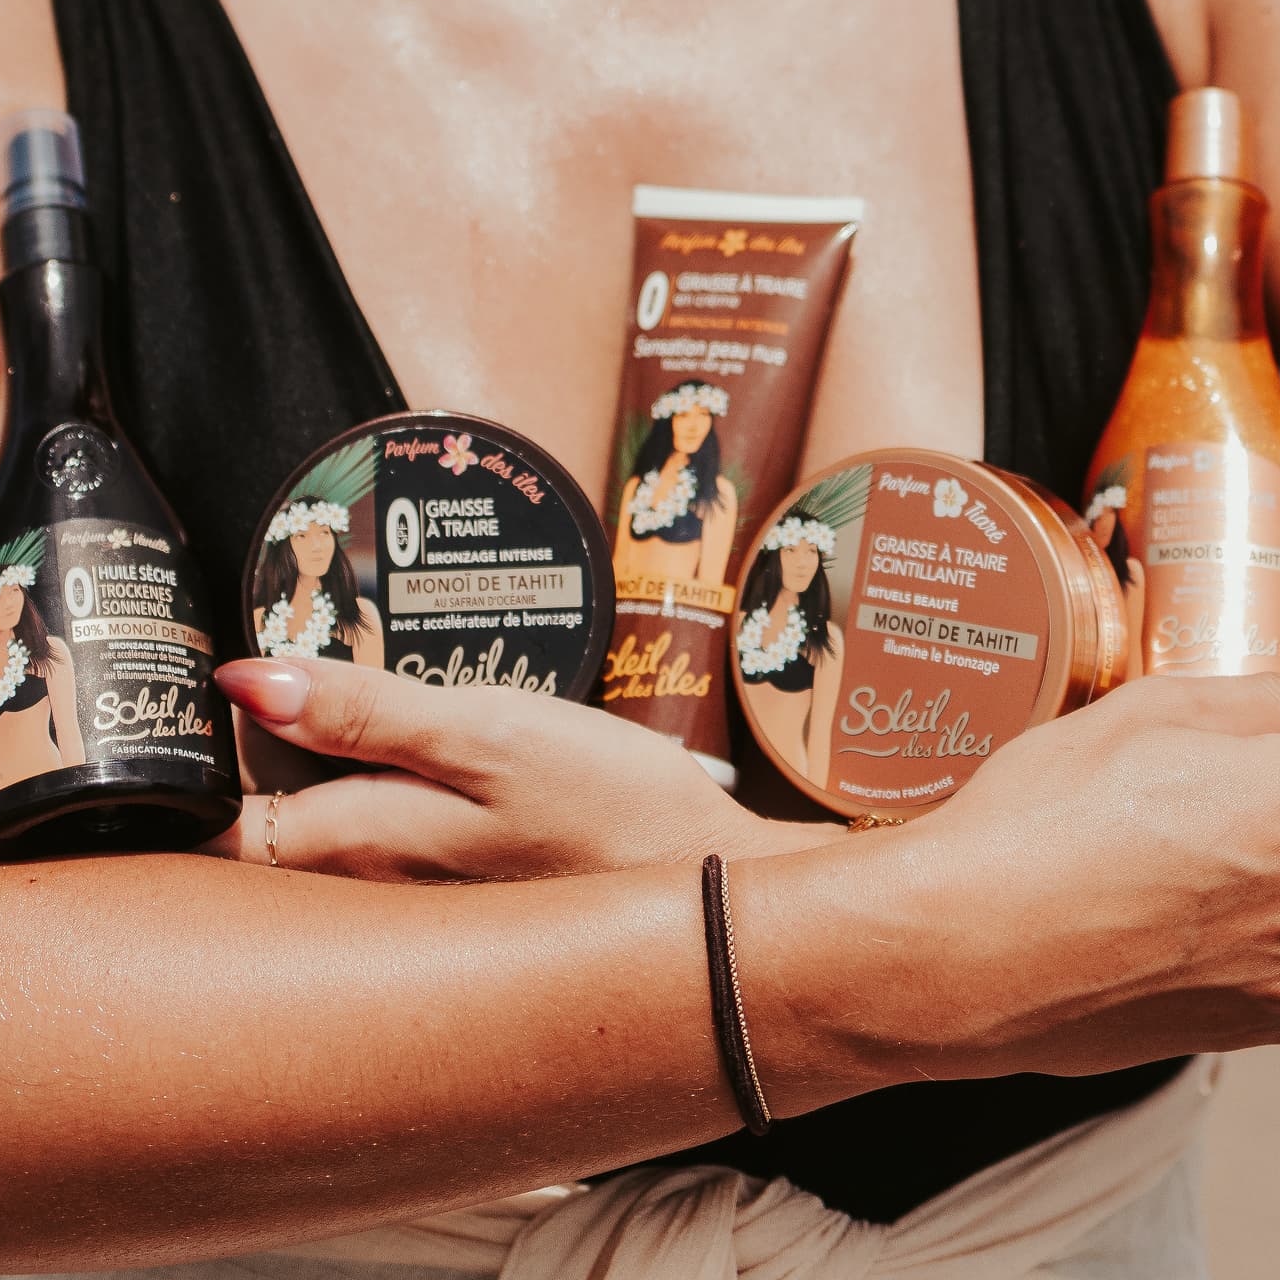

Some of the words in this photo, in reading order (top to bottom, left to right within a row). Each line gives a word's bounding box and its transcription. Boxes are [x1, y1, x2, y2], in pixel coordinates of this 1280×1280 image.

[676, 273, 738, 293] GRAISSE
[740, 272, 753, 293] À
[754, 274, 808, 300] TRAIRE
[637, 271, 669, 331] 0
[634, 335, 707, 359] Sensation
[708, 340, 751, 363] peau
[752, 344, 788, 367] nue
[385, 437, 439, 462] Parfum
[480, 452, 513, 480] des
[425, 497, 495, 519] GRAISSE
[878, 472, 930, 498] Parfum
[964, 500, 1007, 544] Tiaré
[61, 532, 107, 548] Parfum
[386, 497, 420, 567] 0
[426, 518, 440, 538] À
[442, 519, 501, 538] TRAIRE
[426, 550, 497, 566] BRONZAGE
[499, 547, 553, 563] INTENSE
[875, 535, 938, 560] GRAISSE
[939, 544, 952, 564] À
[955, 548, 1008, 573] TRAIRE
[1159, 544, 1210, 561] MONOÏ
[98, 564, 137, 581] HUILE
[139, 563, 177, 587] SÈCHE
[406, 570, 471, 595] MONOÏ
[478, 577, 501, 592] DE
[508, 574, 564, 591] TAHITI
[872, 557, 977, 588] SCINTILLANTE
[65, 567, 94, 617] 0
[98, 584, 174, 603] TROCKENES
[434, 598, 447, 609] AU
[449, 596, 484, 608] SAFRAN
[487, 592, 537, 608] D'OCÉANIE
[617, 577, 643, 595] NOÏ
[646, 580, 665, 595] DE
[674, 583, 723, 607] TAHITI
[866, 587, 911, 604] RITUELS
[913, 596, 959, 612] BEAUTÉ
[101, 600, 173, 619] SONNENÖL
[390, 618, 421, 632] avec
[422, 613, 500, 631] accélérateur
[504, 612, 520, 627] de
[522, 612, 583, 630] bronzage
[74, 626, 104, 639] 50%
[108, 622, 157, 637] MONOÏ
[162, 626, 178, 640] DE
[873, 612, 934, 637] MONOÏ
[938, 623, 960, 642] DE
[967, 628, 1019, 654] TAHITI
[1151, 613, 1222, 655] Sole
[1247, 624, 1279, 658] les
[99, 652, 117, 661] avec
[117, 650, 159, 661] accélérateur
[159, 651, 168, 661] de
[168, 652, 196, 669] bronzage
[108, 640, 155, 651] BRONZAGE
[155, 642, 188, 657] INTENSE
[883, 639, 929, 660] illumine
[930, 647, 942, 663] le
[944, 651, 1000, 676] bronzage
[103, 672, 115, 681] mit
[112, 662, 156, 672] INTENSIVE
[157, 663, 189, 677] BRÄUNE
[499, 655, 557, 696] les
[654, 651, 712, 697] îles
[94, 685, 179, 730] Soleil
[152, 718, 175, 738] des
[177, 702, 213, 737] îles
[839, 686, 951, 736] Soleil
[901, 733, 933, 758] des
[935, 711, 993, 758] îles
[111, 745, 172, 756] FABRICATION
[173, 747, 215, 766] FRANÇAISE
[839, 781, 900, 800] FABRICATION
[903, 776, 954, 799] FRANÇAISE
